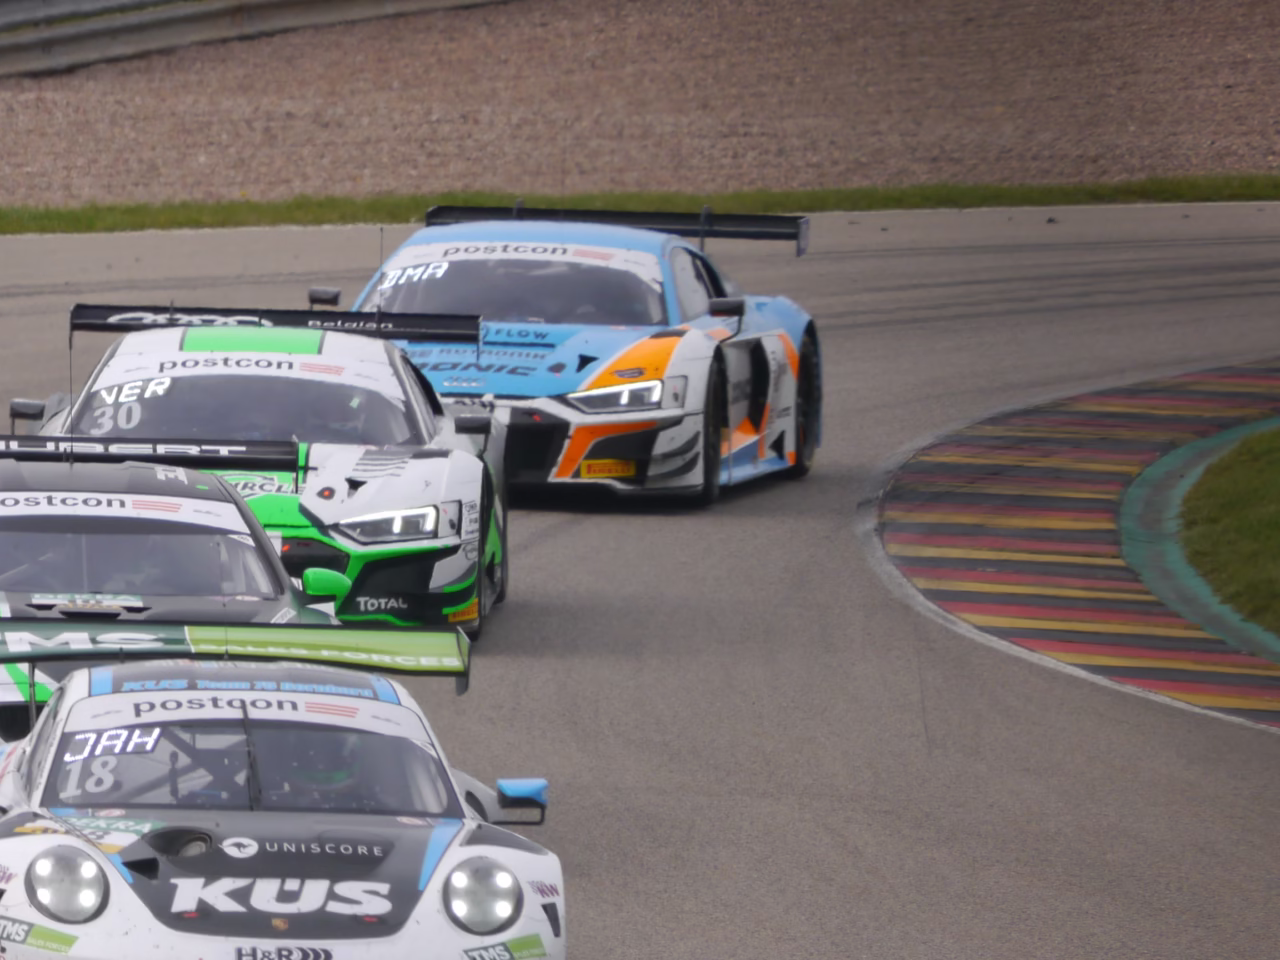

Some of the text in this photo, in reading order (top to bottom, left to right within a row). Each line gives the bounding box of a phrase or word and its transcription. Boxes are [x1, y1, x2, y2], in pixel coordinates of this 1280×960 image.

[442, 244, 568, 258] postcon
[308, 320, 393, 330] Belgian
[494, 328, 551, 341] FLOW
[158, 356, 294, 372] postcon
[100, 376, 171, 405] VER
[90, 403, 142, 436] 30
[321, 649, 462, 667] FORCES
[133, 696, 299, 718] postcon
[64, 727, 161, 763] JAH
[58, 755, 118, 800] 18
[265, 842, 384, 857] UNISCORE
[169, 877, 393, 916] KÜS
